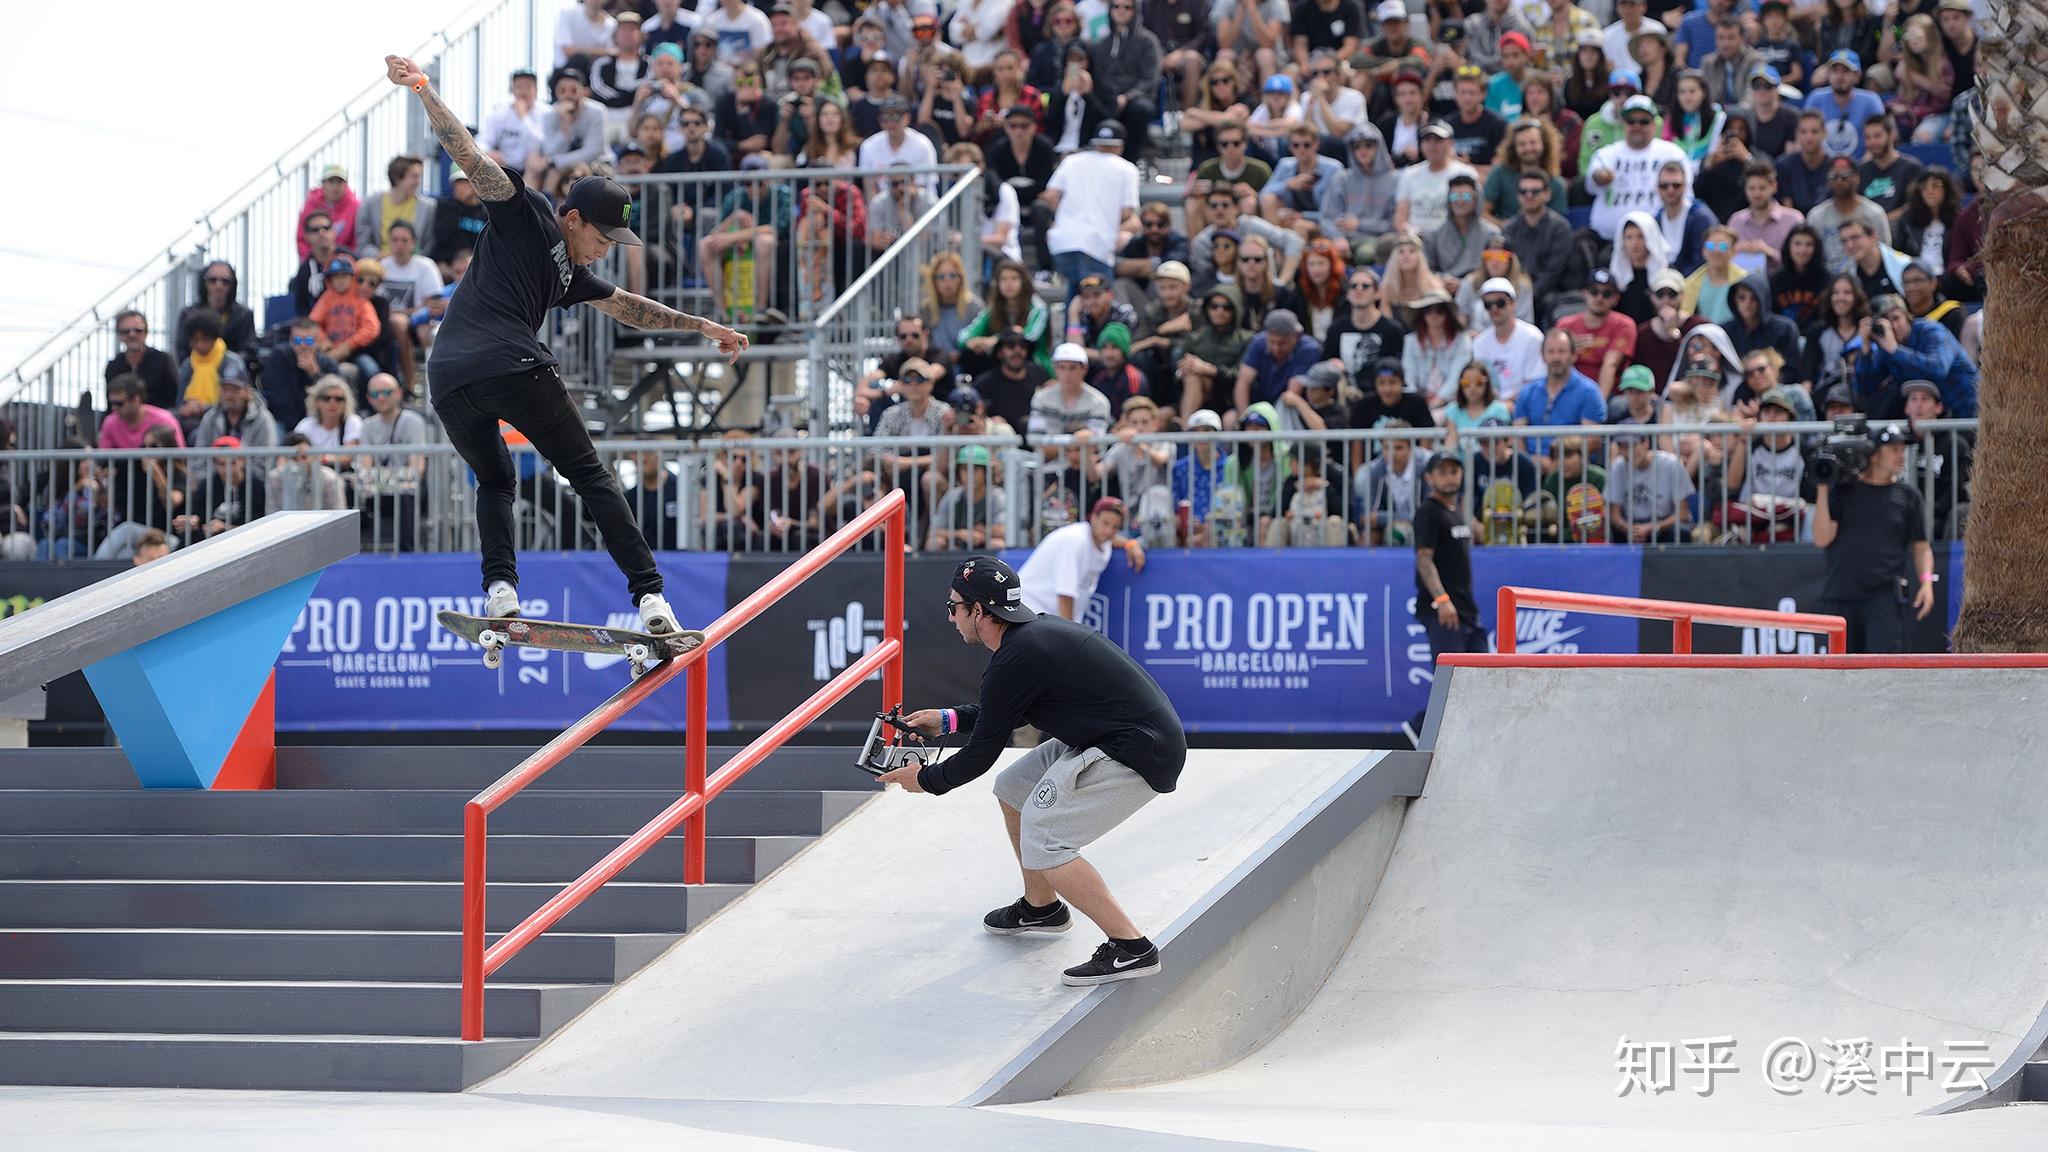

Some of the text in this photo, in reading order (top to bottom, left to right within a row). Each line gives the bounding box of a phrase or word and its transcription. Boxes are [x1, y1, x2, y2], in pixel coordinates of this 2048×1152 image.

[518, 599, 549, 685] 206
[1144, 592, 1233, 651] PRO
[1247, 591, 1369, 652] OPEN
[332, 652, 433, 674] BARCELONA
[1201, 651, 1310, 673] BARCELONA
